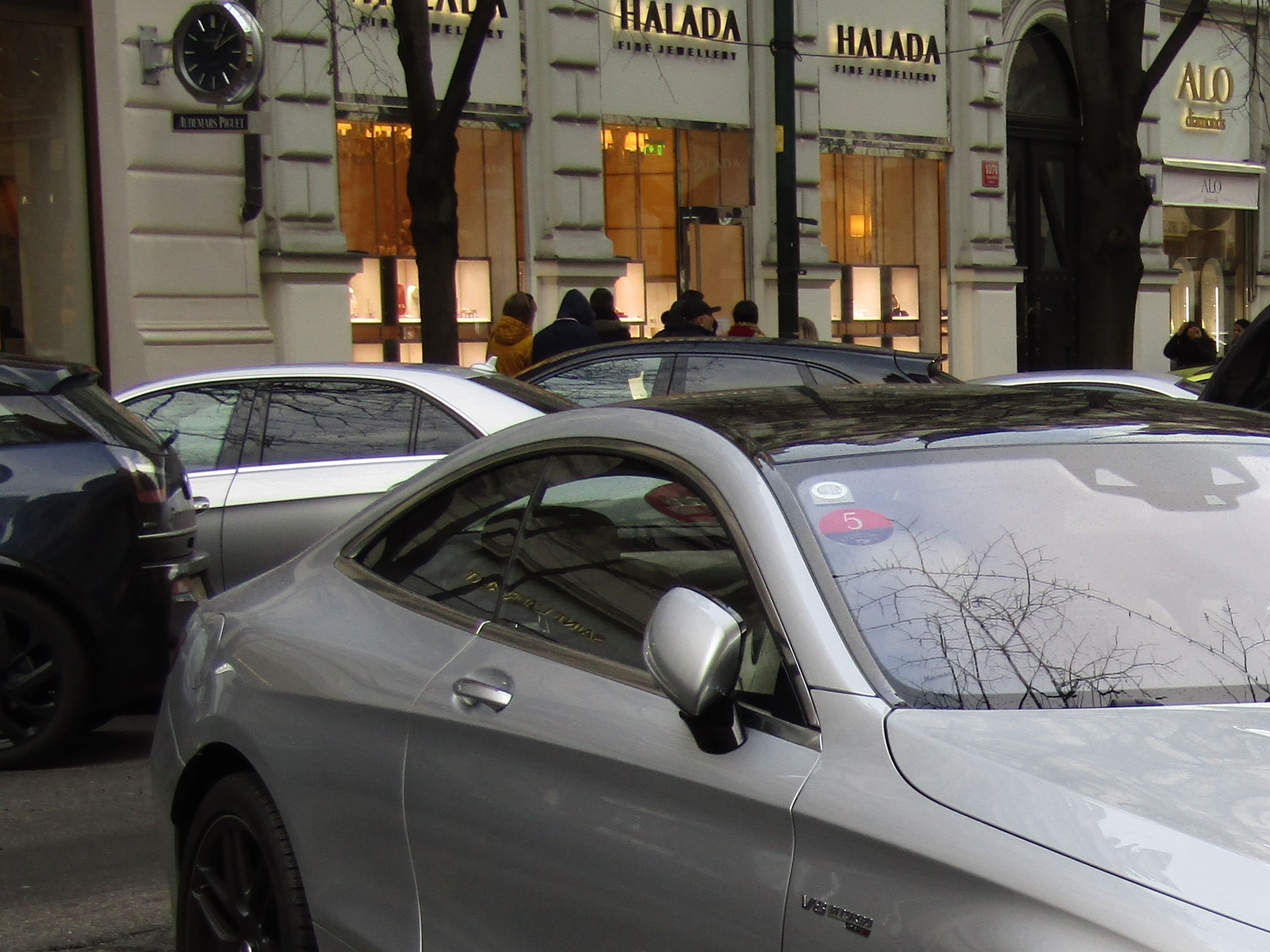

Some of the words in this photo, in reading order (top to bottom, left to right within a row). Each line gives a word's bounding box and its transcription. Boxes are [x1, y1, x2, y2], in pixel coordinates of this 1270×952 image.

[619, 0, 742, 42] HALADA
[618, 41, 652, 53] FINE
[659, 45, 737, 61] JEWELLERY
[837, 25, 942, 65] HALADA
[835, 64, 865, 76] FINE
[869, 68, 937, 83] JEWELLERY
[1178, 62, 1234, 105] ALO
[180, 116, 218, 129] AUDEMARS
[219, 115, 245, 129] PIGUET
[1201, 179, 1222, 195] ALO
[843, 512, 864, 531] 5
